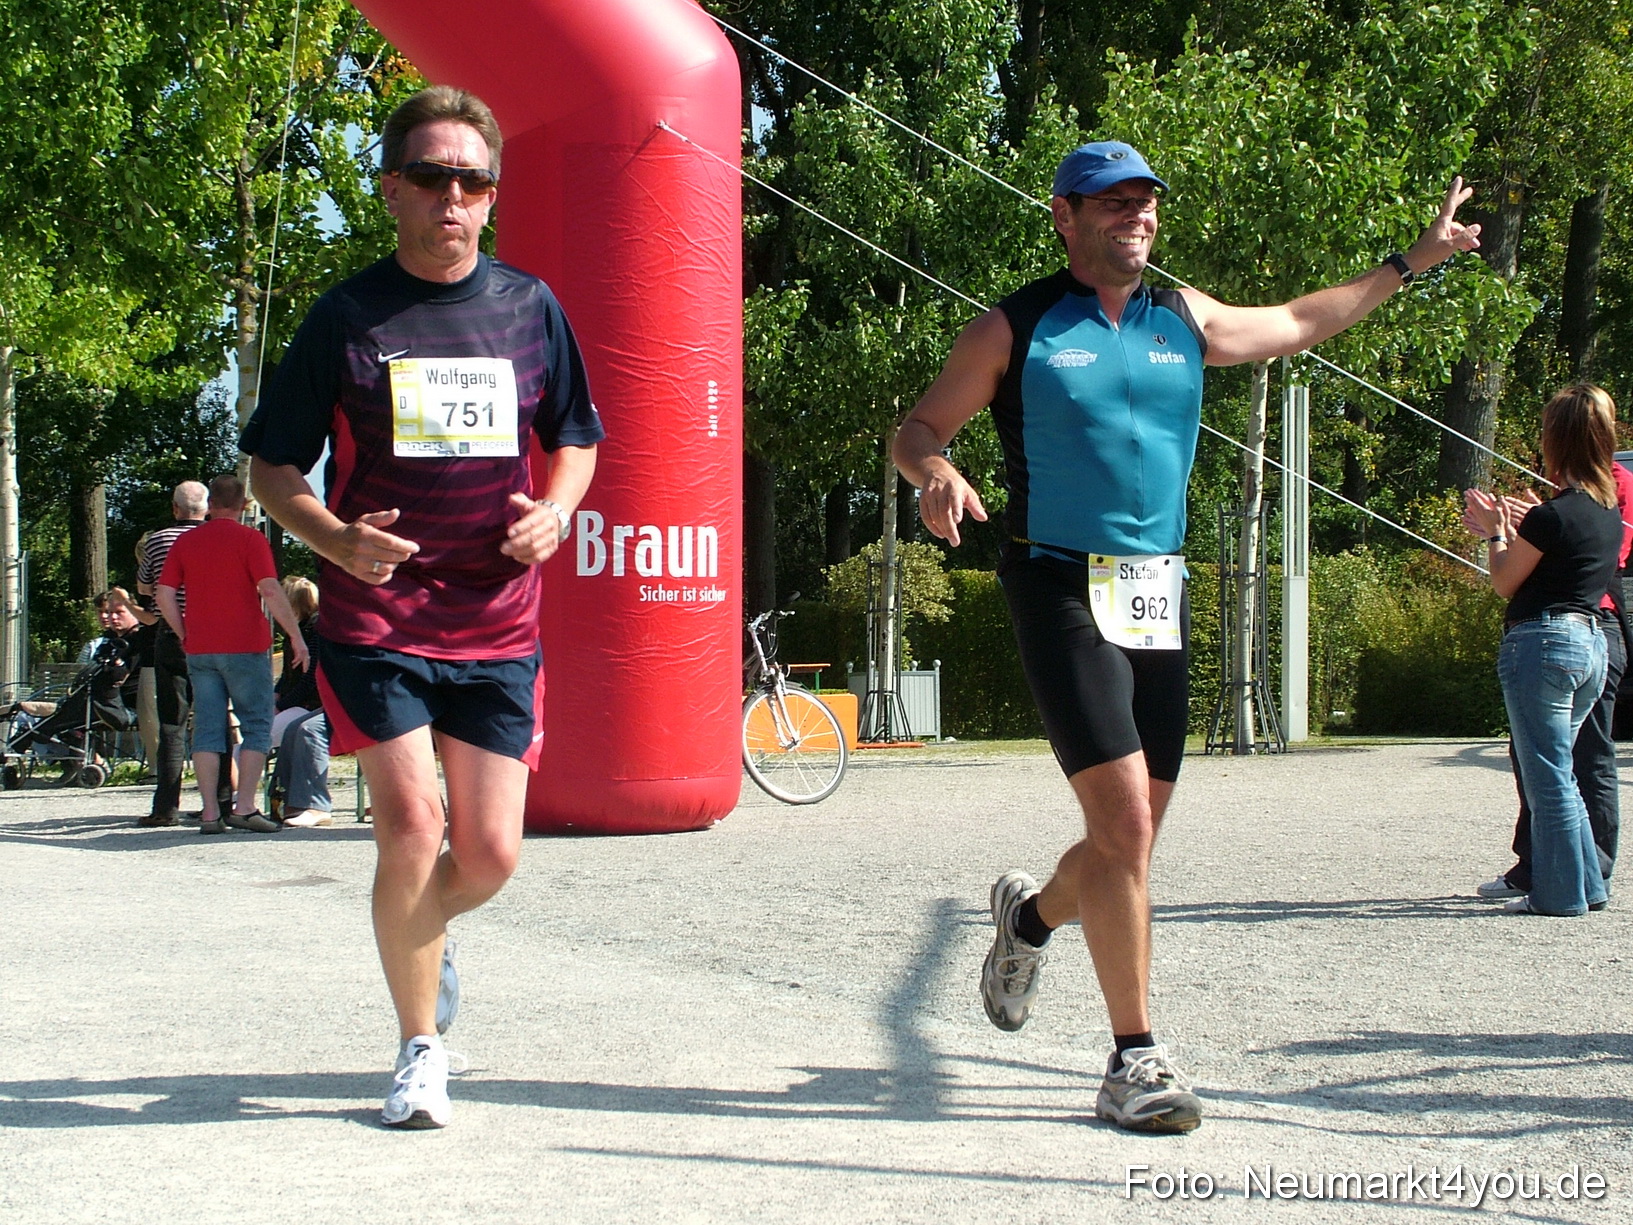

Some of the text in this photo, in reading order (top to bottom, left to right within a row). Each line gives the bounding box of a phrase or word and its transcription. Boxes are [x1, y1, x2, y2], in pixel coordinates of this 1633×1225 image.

[1148, 351, 1186, 364] Stefan
[425, 368, 497, 389] Wolfgang
[707, 380, 719, 410] 1929
[441, 402, 494, 428] 751
[576, 510, 718, 578] Braun
[1119, 563, 1159, 580] Stefan
[639, 584, 726, 602] Sicher ist sicher
[1131, 595, 1169, 620] 962
